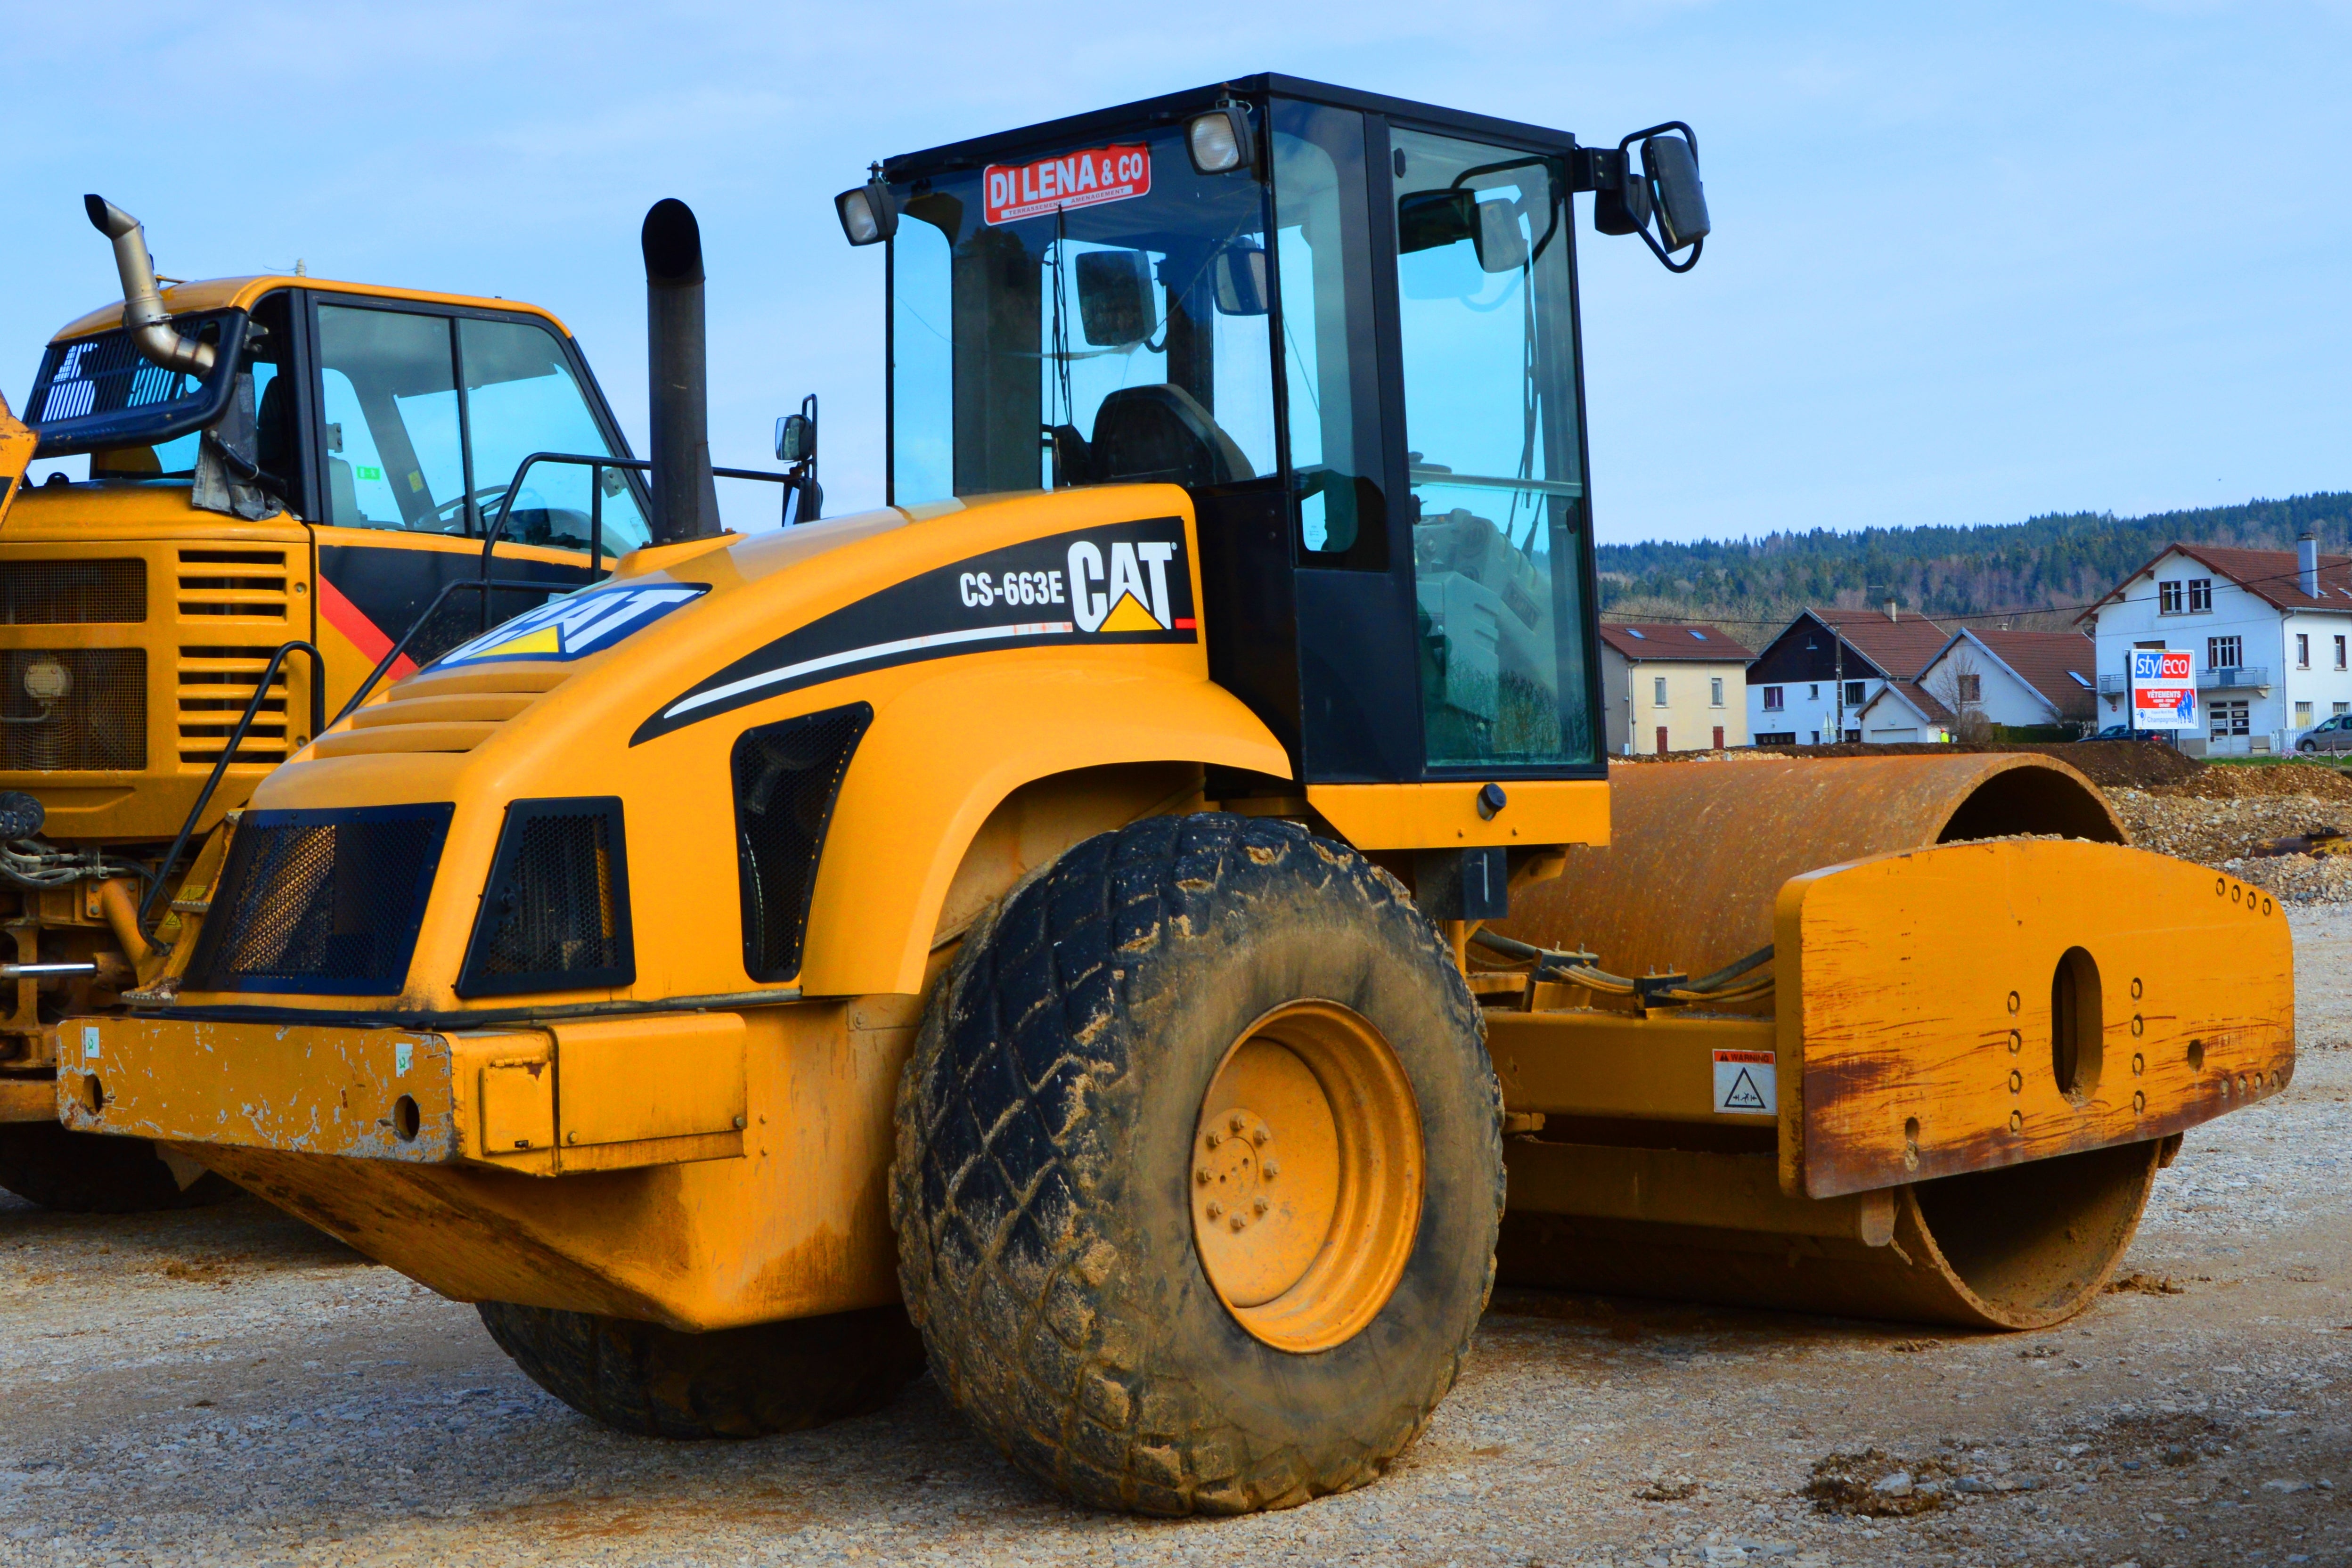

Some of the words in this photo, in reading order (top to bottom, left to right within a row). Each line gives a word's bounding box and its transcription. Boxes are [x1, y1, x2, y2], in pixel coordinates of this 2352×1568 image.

[990, 170, 1016, 208] DI
[1022, 155, 1098, 202] LENA
[1101, 159, 1114, 186] &
[1118, 153, 1143, 182] CO
[1008, 201, 1062, 215] TERRASSEMENT
[1071, 188, 1125, 204] AMENAGEMENT
[960, 571, 1065, 607] CS-663E
[1068, 541, 1173, 633] CAT
[2136, 655, 2188, 678] styleco
[2147, 689, 2181, 698] VÊTEMENTS
[1731, 1054, 1770, 1062] WARNING
